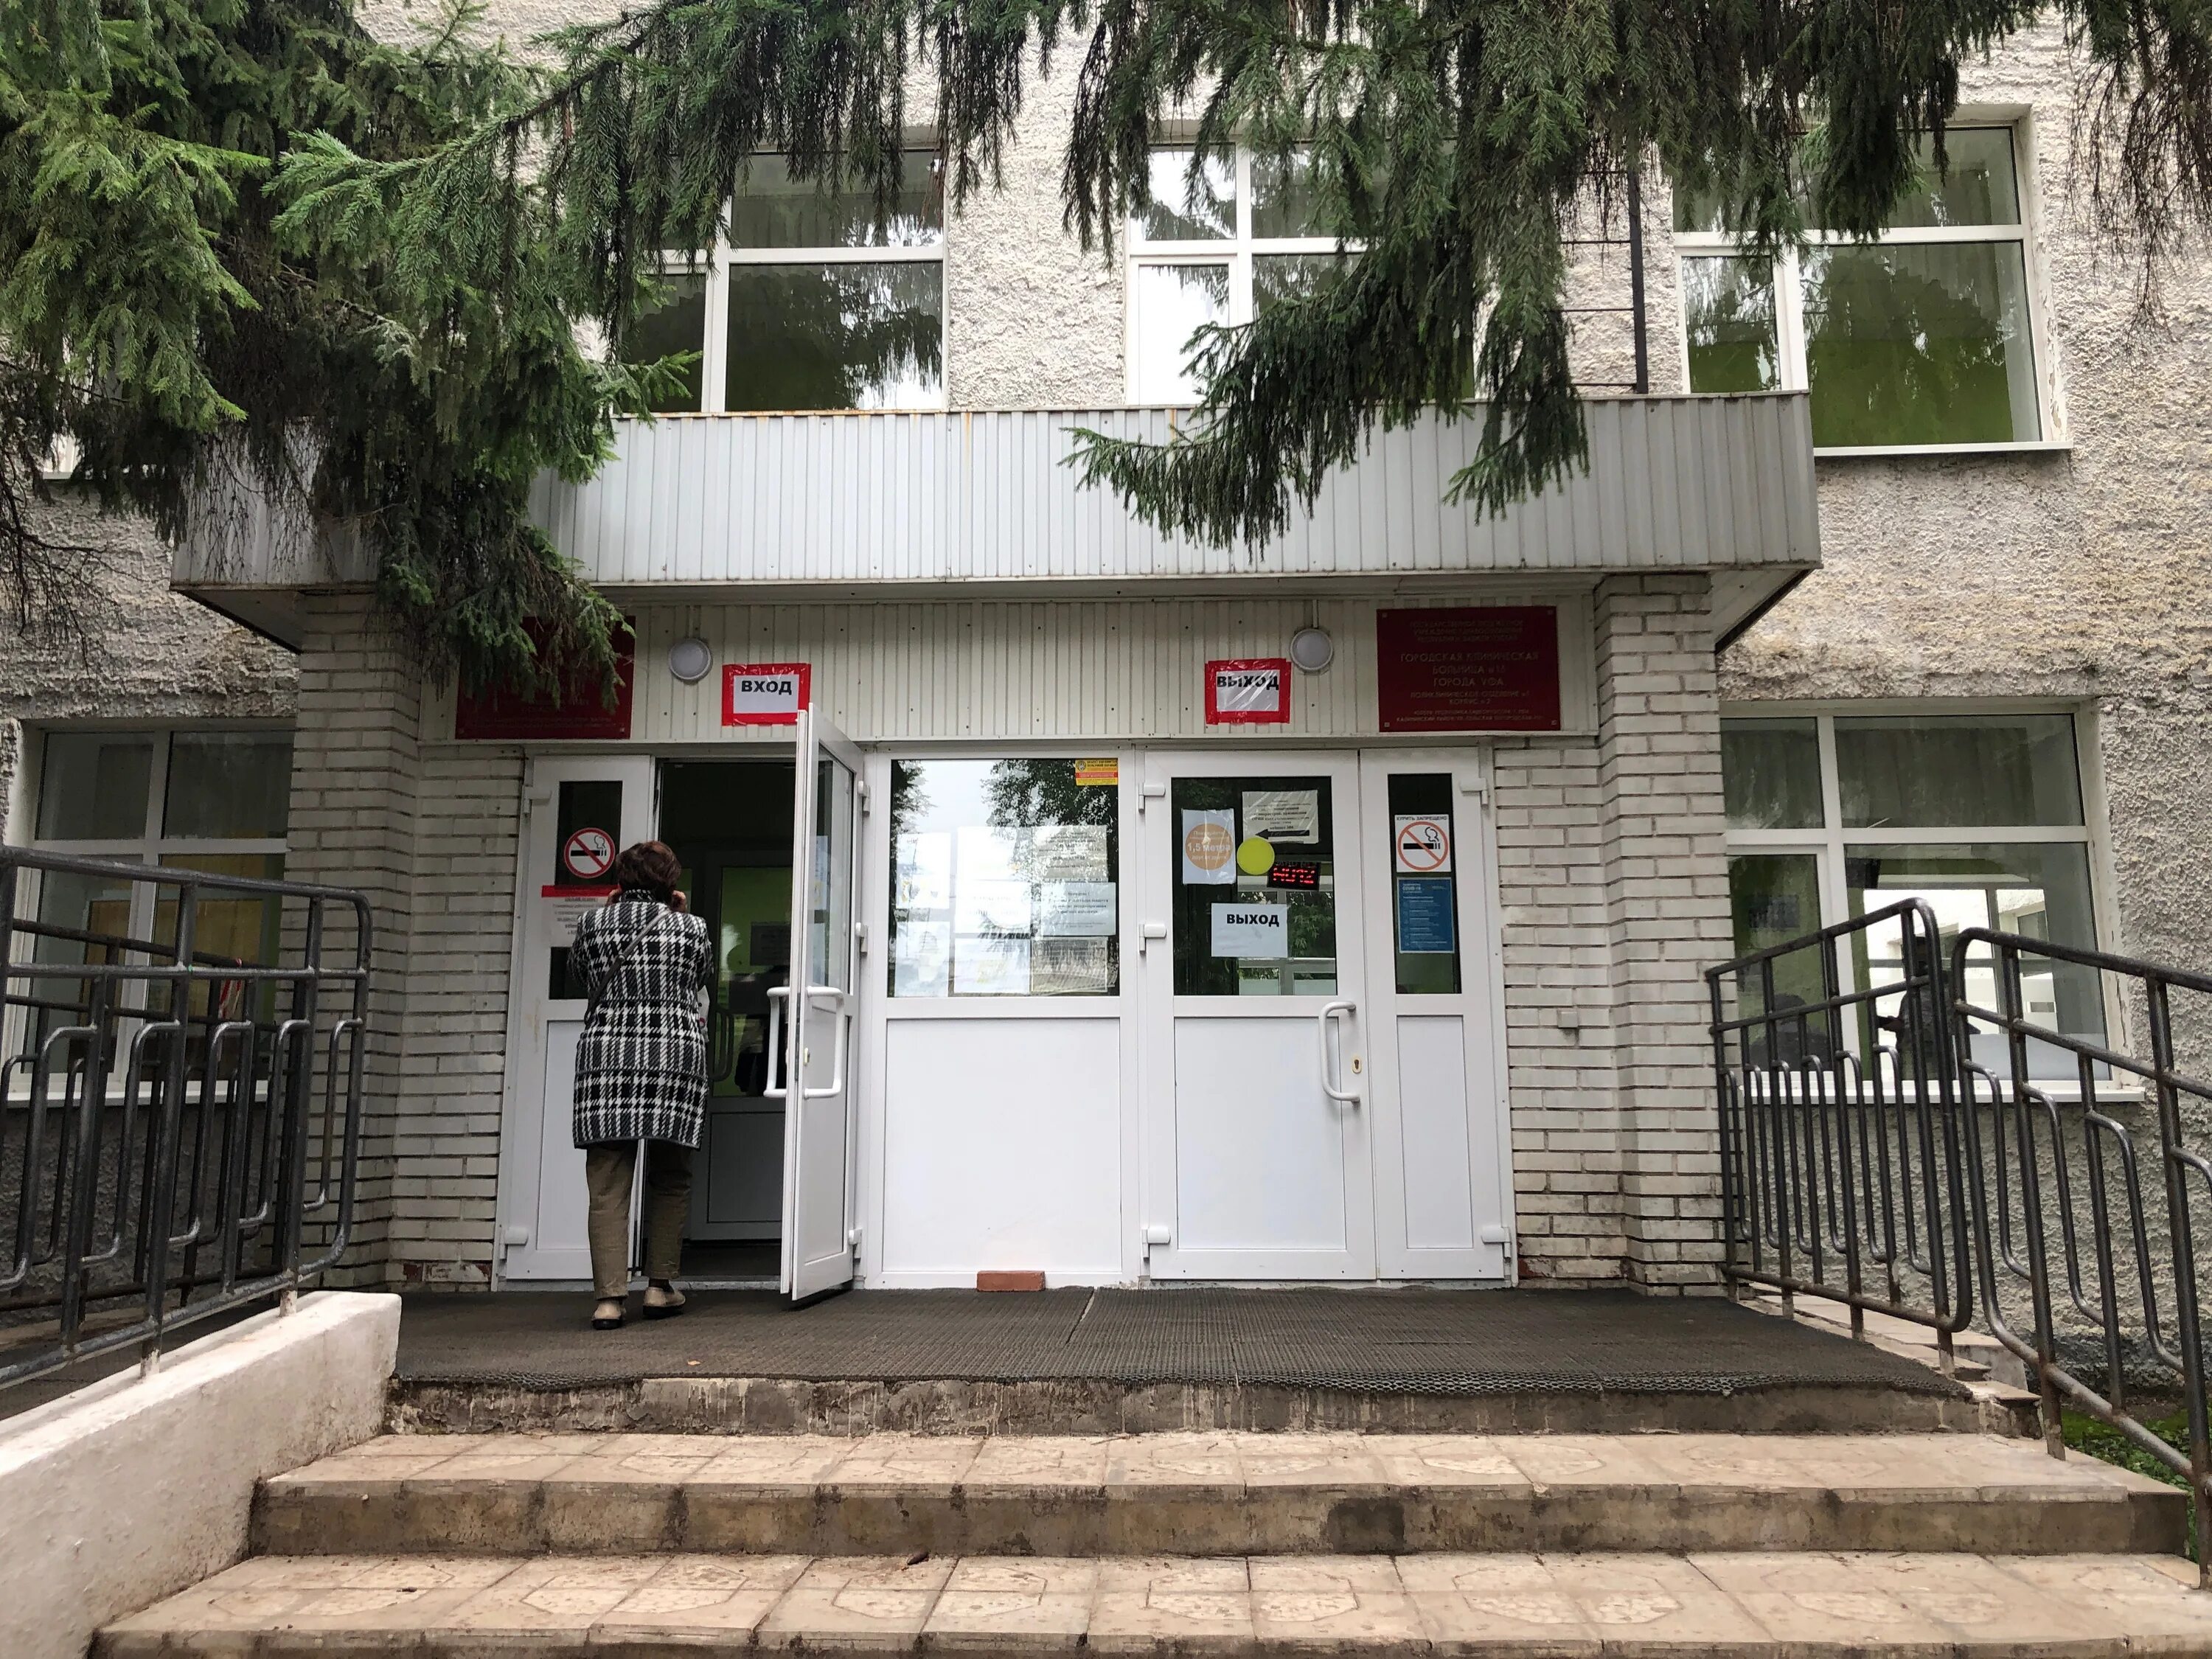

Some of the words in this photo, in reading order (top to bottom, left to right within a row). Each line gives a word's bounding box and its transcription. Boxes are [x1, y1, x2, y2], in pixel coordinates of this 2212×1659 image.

[1400, 653, 1463, 662] ГОРОДСКАЯ
[1432, 665, 1486, 675] БОЛЬНИЦА
[741, 680, 792, 695] ВХОД
[1216, 675, 1279, 690] ВЫХОД
[1433, 678, 1476, 686] ГОРОДА
[1187, 842, 1201, 853] 1,5
[1226, 914, 1280, 928] ВЫХОД
